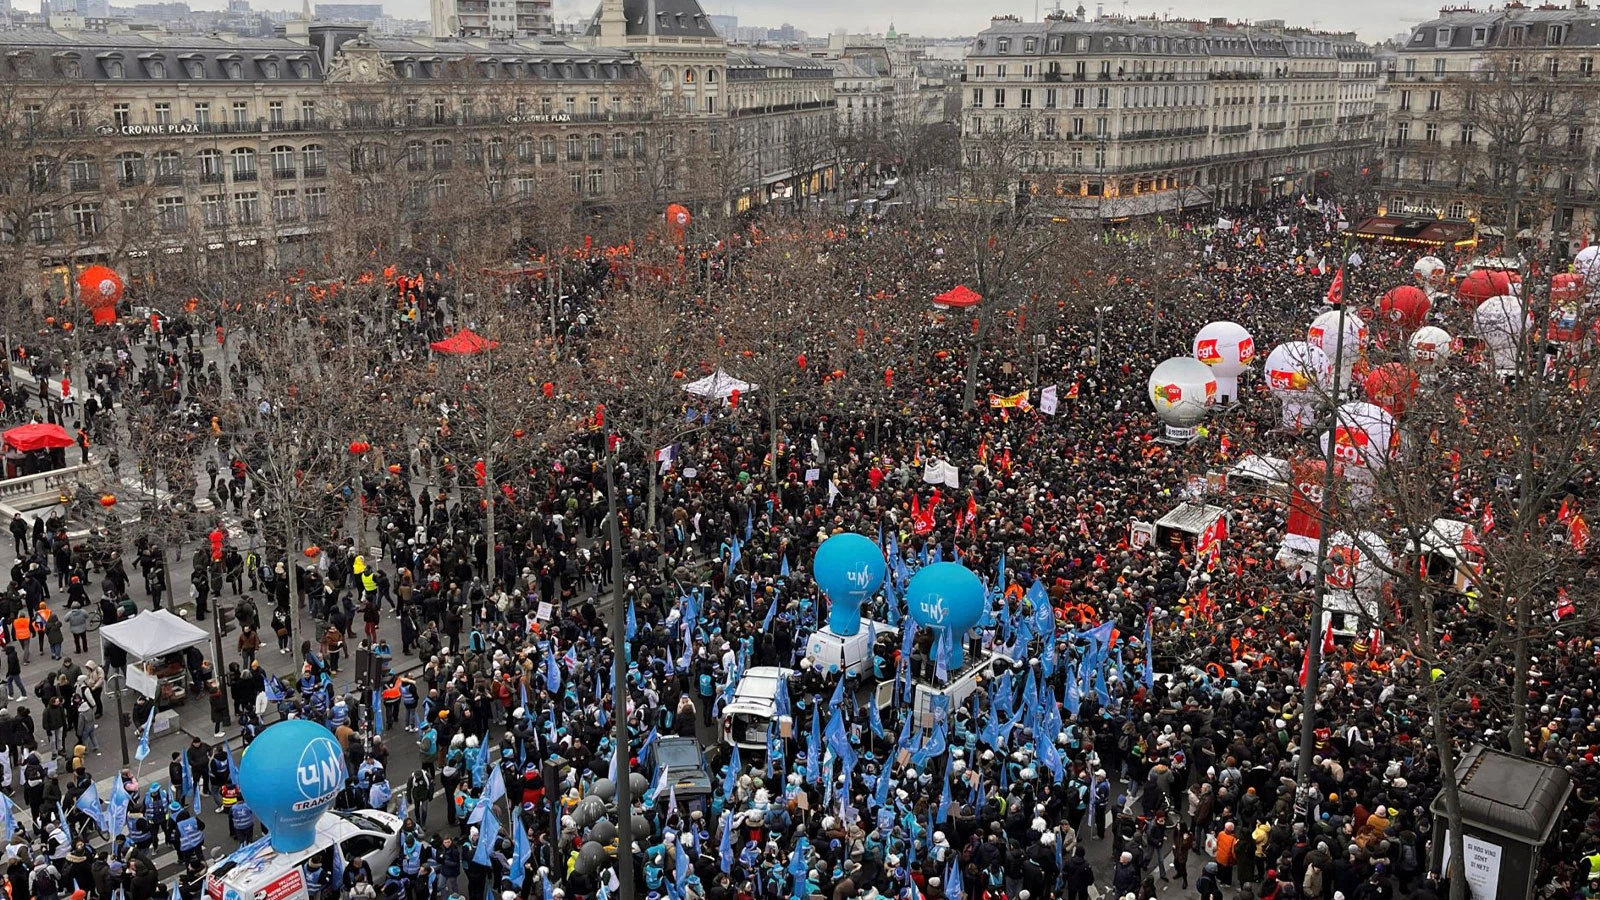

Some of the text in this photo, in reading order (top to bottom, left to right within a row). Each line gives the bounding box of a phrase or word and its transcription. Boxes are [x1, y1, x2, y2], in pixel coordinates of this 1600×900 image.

[551, 113, 571, 121] PLAZA
[121, 124, 165, 135] CROWNE
[168, 123, 199, 133] PLAZA
[1403, 205, 1423, 214] PIZZA
[1198, 345, 1214, 358] cgt
[1272, 377, 1290, 390] cgt
[1299, 481, 1323, 503] cg
